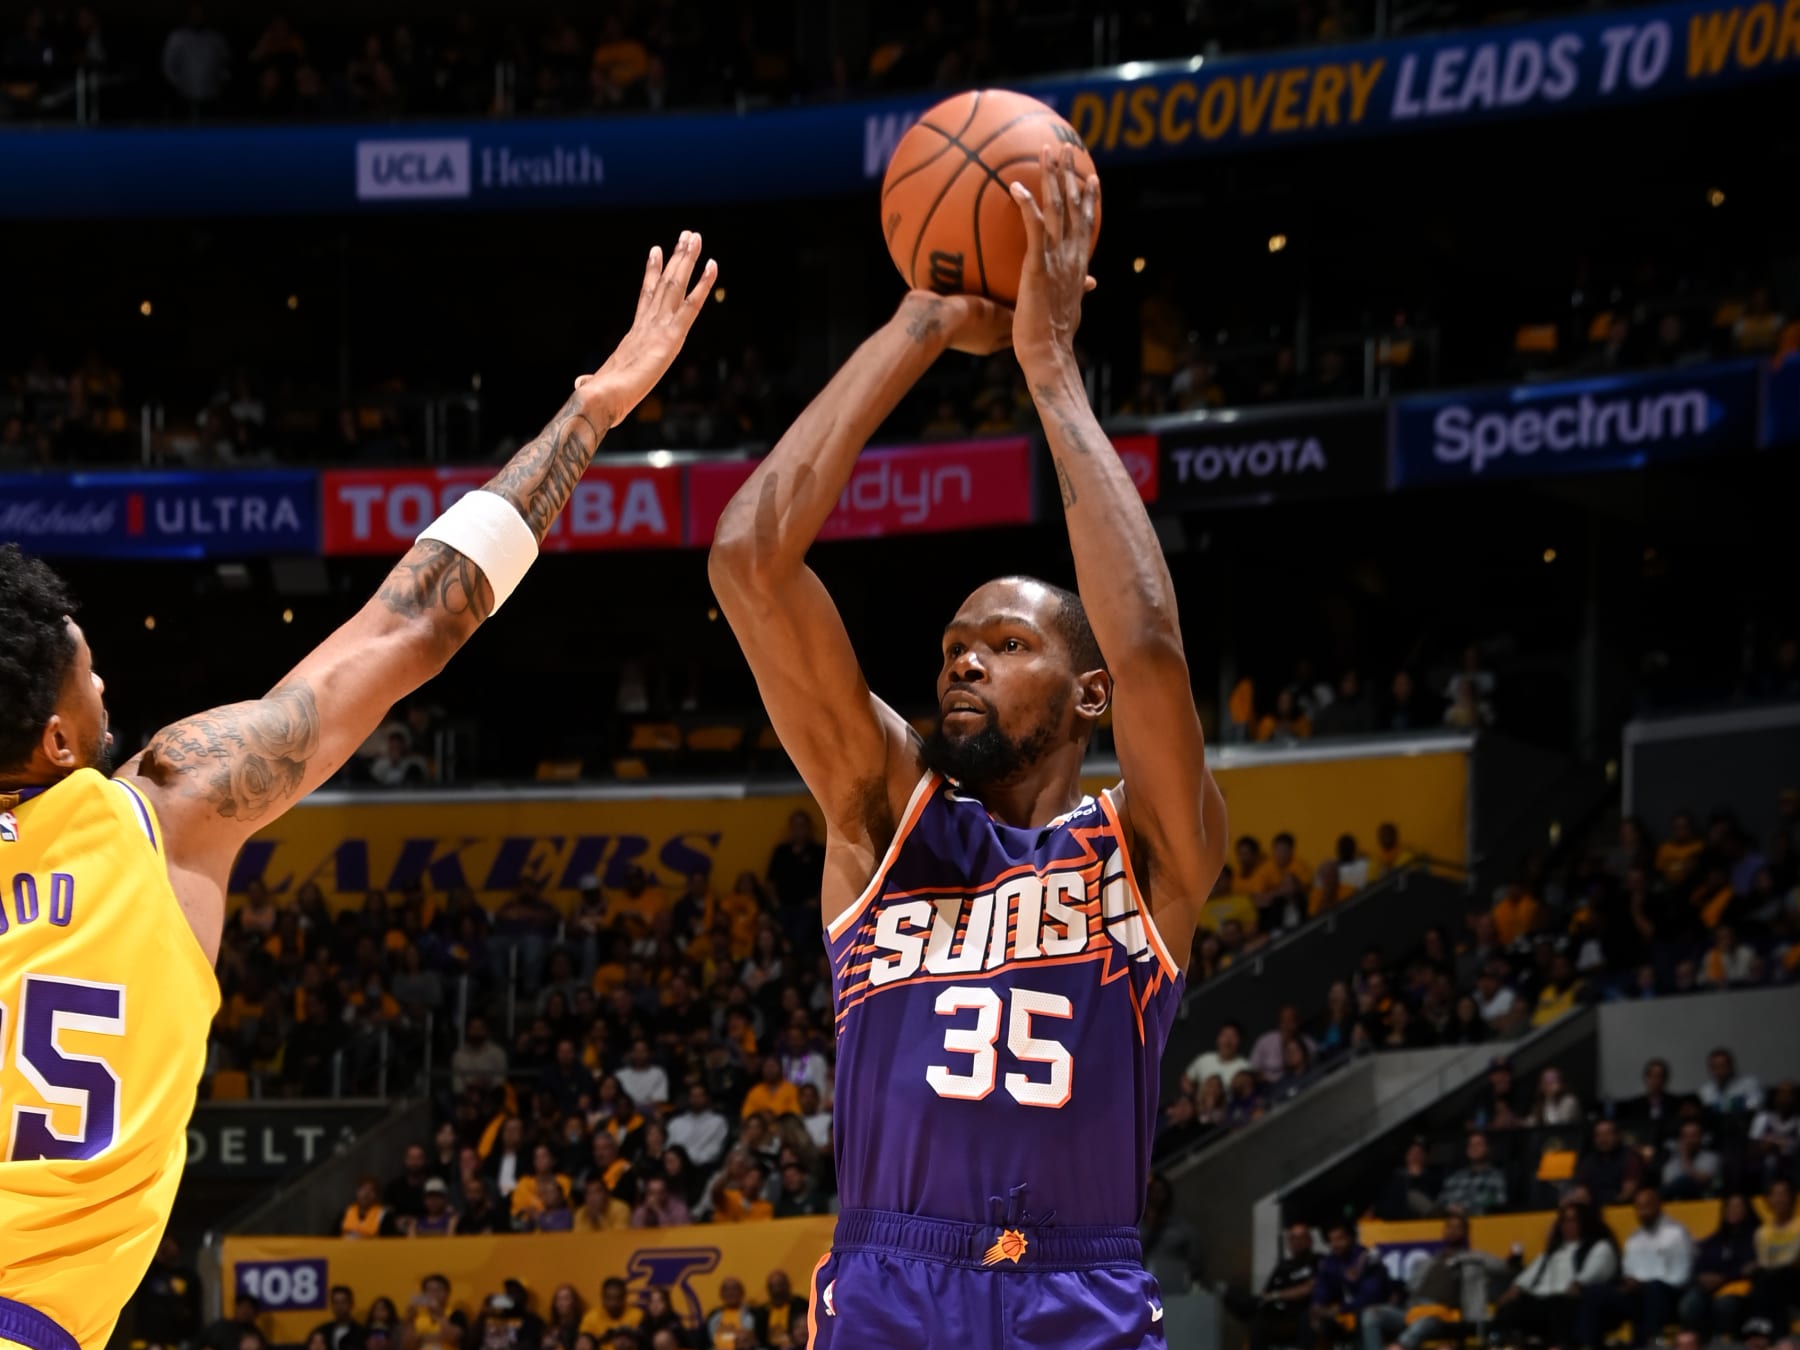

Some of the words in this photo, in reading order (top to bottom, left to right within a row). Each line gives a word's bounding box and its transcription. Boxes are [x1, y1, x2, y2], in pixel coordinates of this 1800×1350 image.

[1071, 59, 1384, 149] DISCOVERY
[1391, 34, 1583, 120] LEADS
[1600, 20, 1672, 95] TO
[373, 153, 456, 184] UCLA
[482, 145, 604, 186] Health
[1171, 437, 1326, 482] TOYOTA
[1433, 391, 1708, 473] Spectrum
[155, 497, 300, 533] ULTRA
[339, 479, 668, 541] TOBA
[226, 832, 722, 894] LAKERS
[869, 871, 1088, 986] SUNS
[926, 986, 1073, 1109] 35
[243, 1266, 318, 1304] 108
